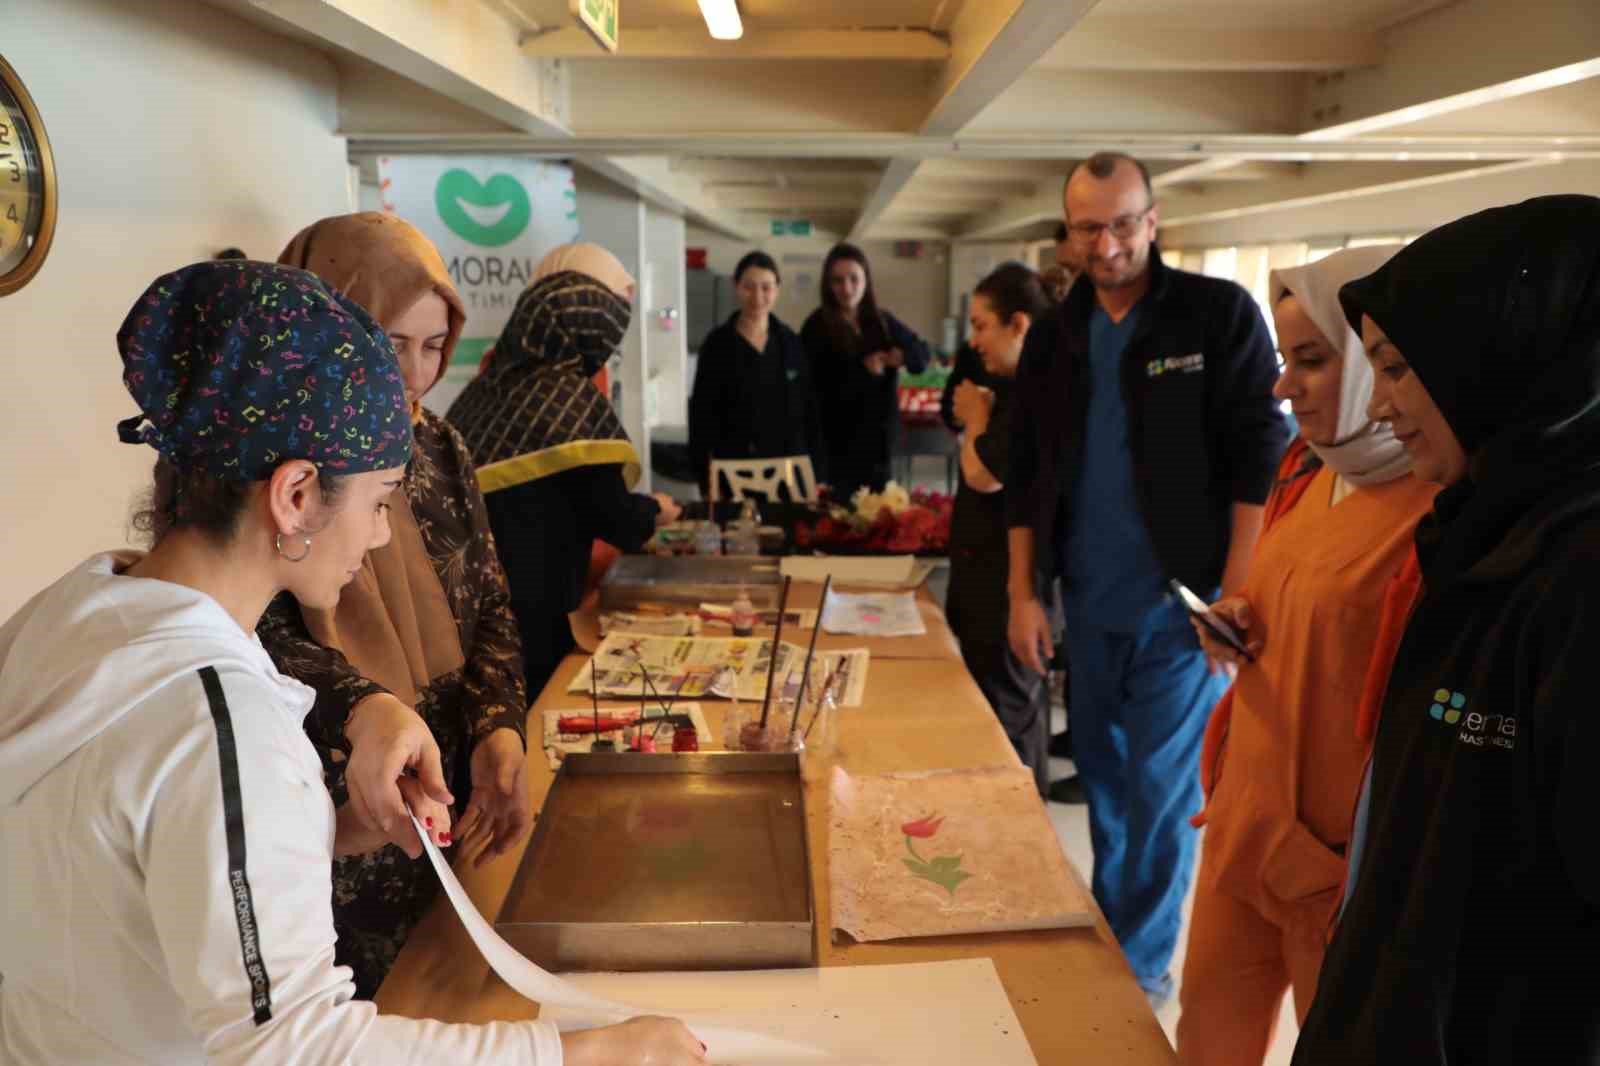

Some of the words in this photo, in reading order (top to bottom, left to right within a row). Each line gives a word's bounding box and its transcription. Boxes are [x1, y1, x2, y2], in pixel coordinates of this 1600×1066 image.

[9, 161, 21, 182] 3
[6, 203, 19, 223] 4
[231, 870, 258, 963] PERFORMANCE
[249, 962, 267, 1009] SPOTS
